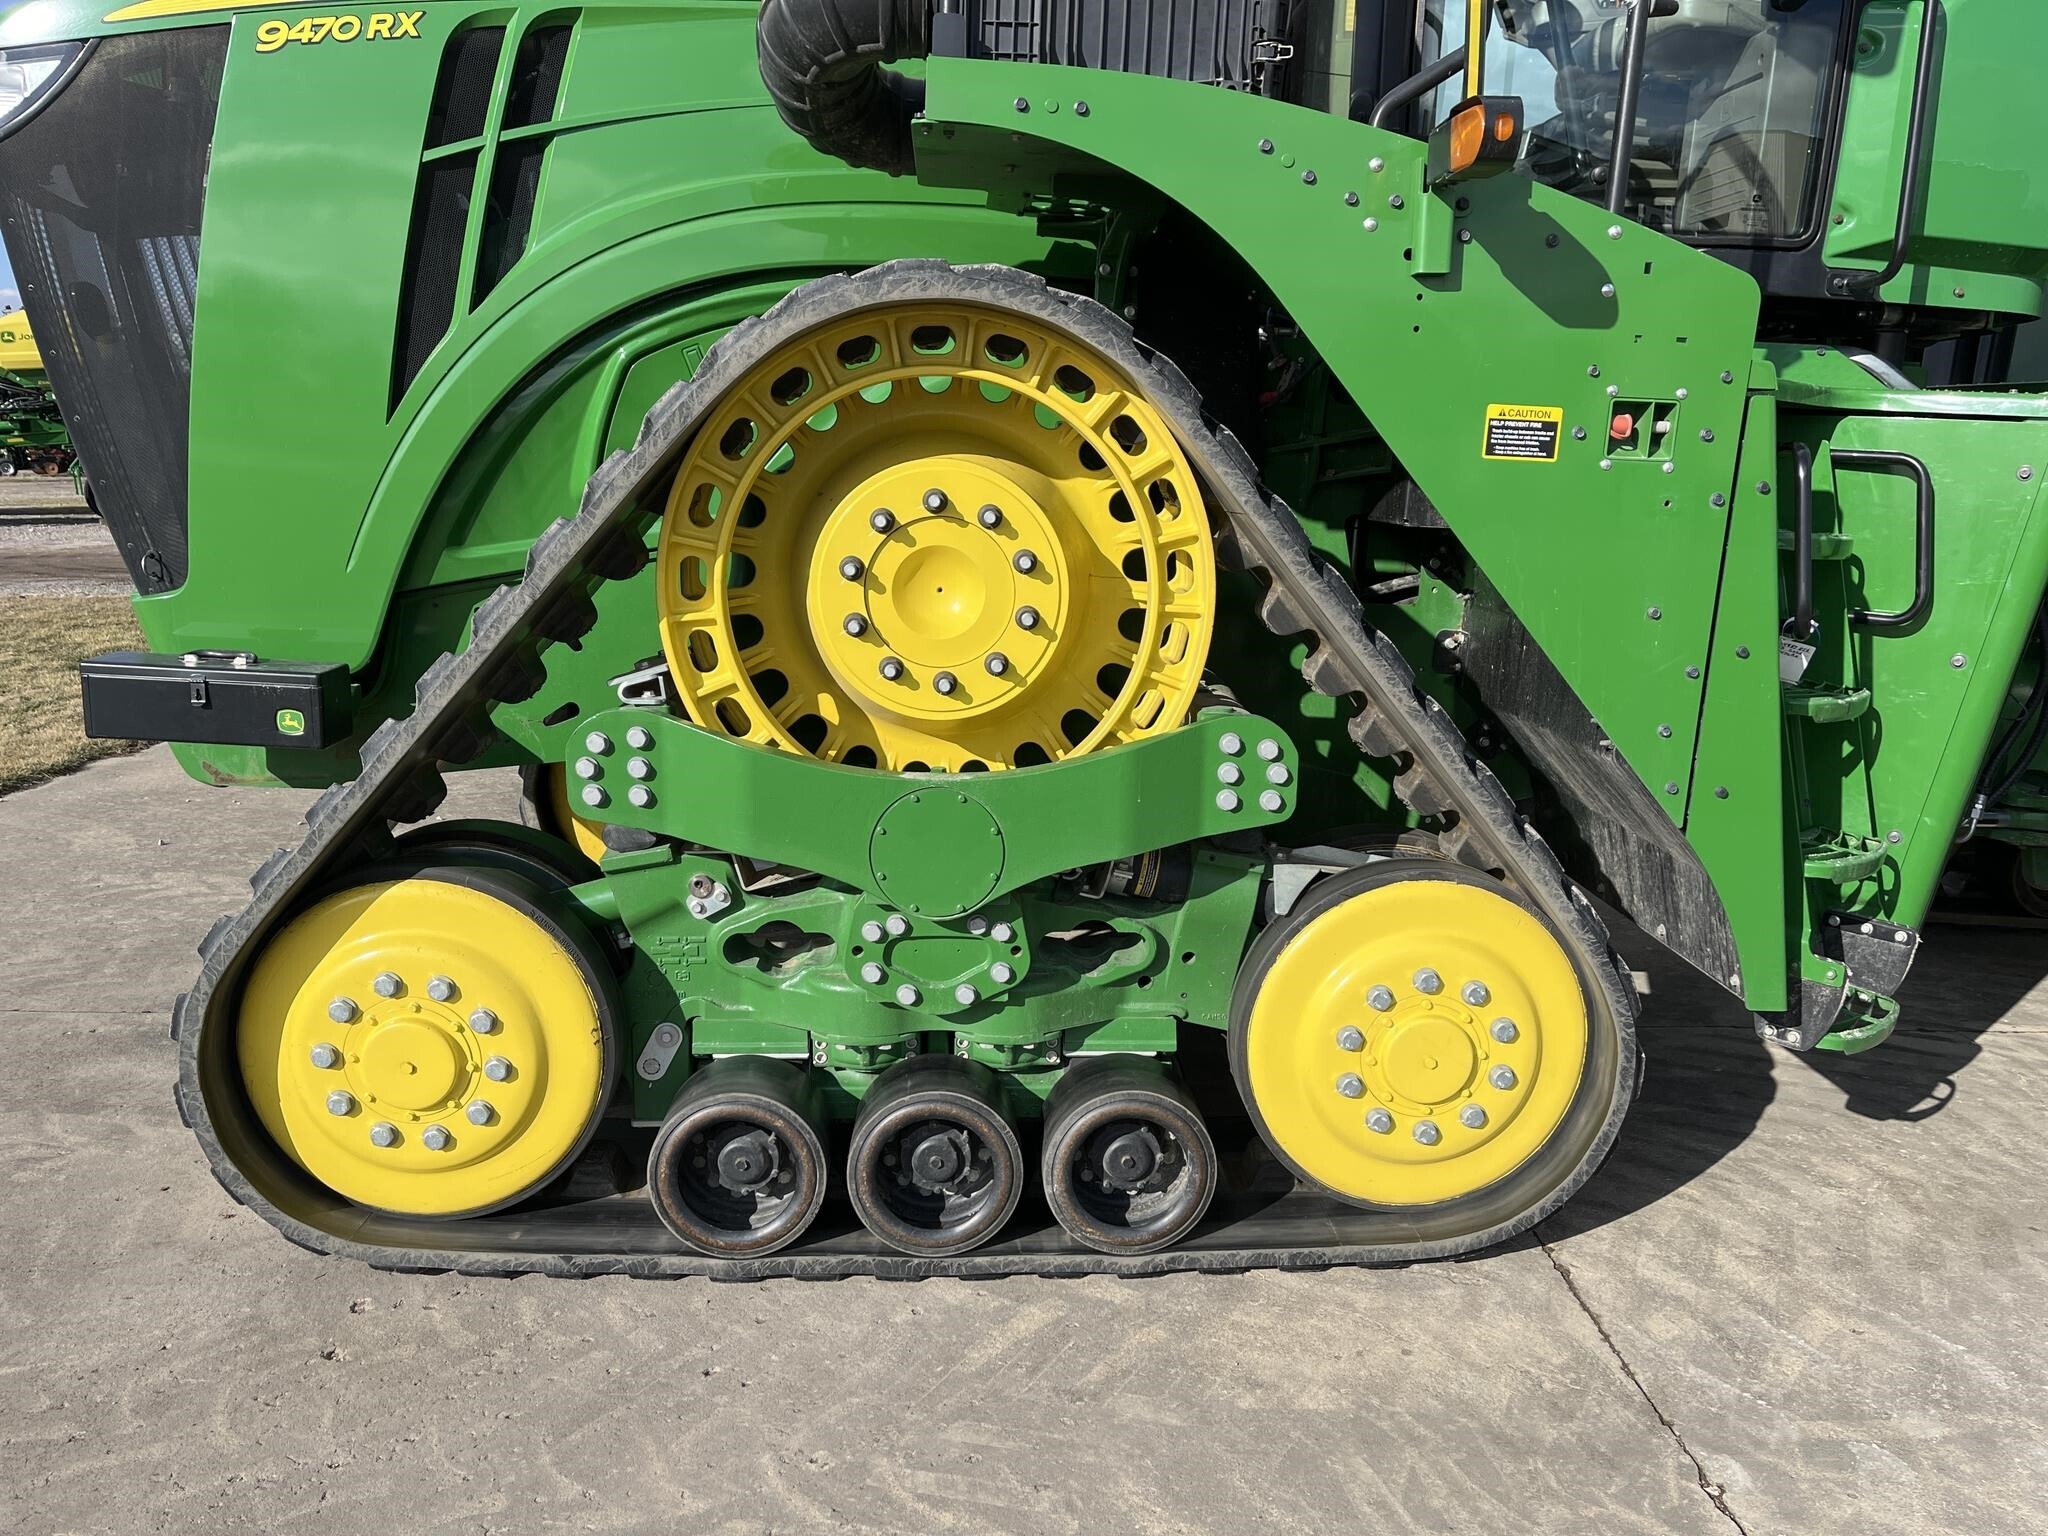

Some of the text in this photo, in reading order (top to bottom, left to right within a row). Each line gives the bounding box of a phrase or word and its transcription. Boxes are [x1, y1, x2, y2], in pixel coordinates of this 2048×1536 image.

[255, 10, 426, 52] 9470 RX
[1508, 409, 1551, 418] CAUTION
